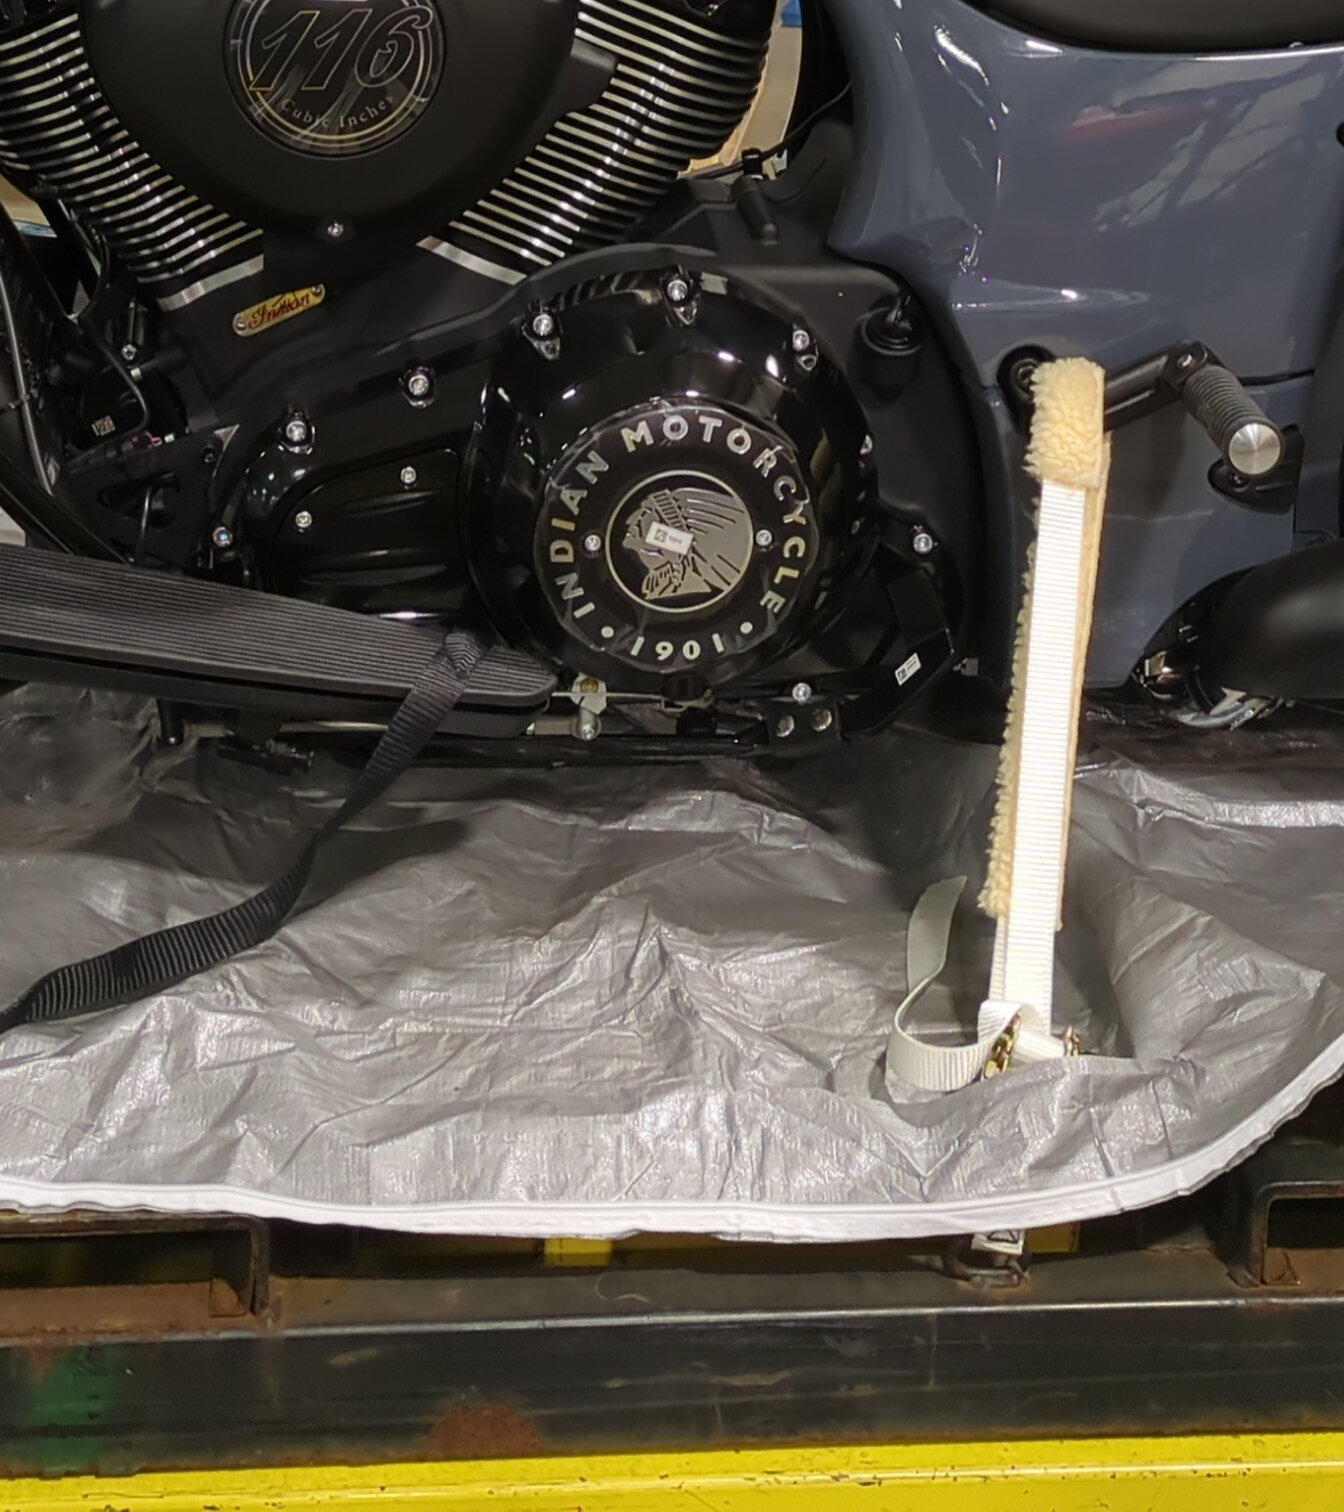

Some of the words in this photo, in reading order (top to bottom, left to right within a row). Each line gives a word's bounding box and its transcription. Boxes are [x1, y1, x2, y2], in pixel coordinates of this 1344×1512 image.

[249, 5, 433, 91] 116
[282, 98, 330, 128] Cubic
[550, 451, 609, 619] INDIAN
[620, 415, 807, 614] MOTORCYCLE
[630, 633, 725, 662] 1901
